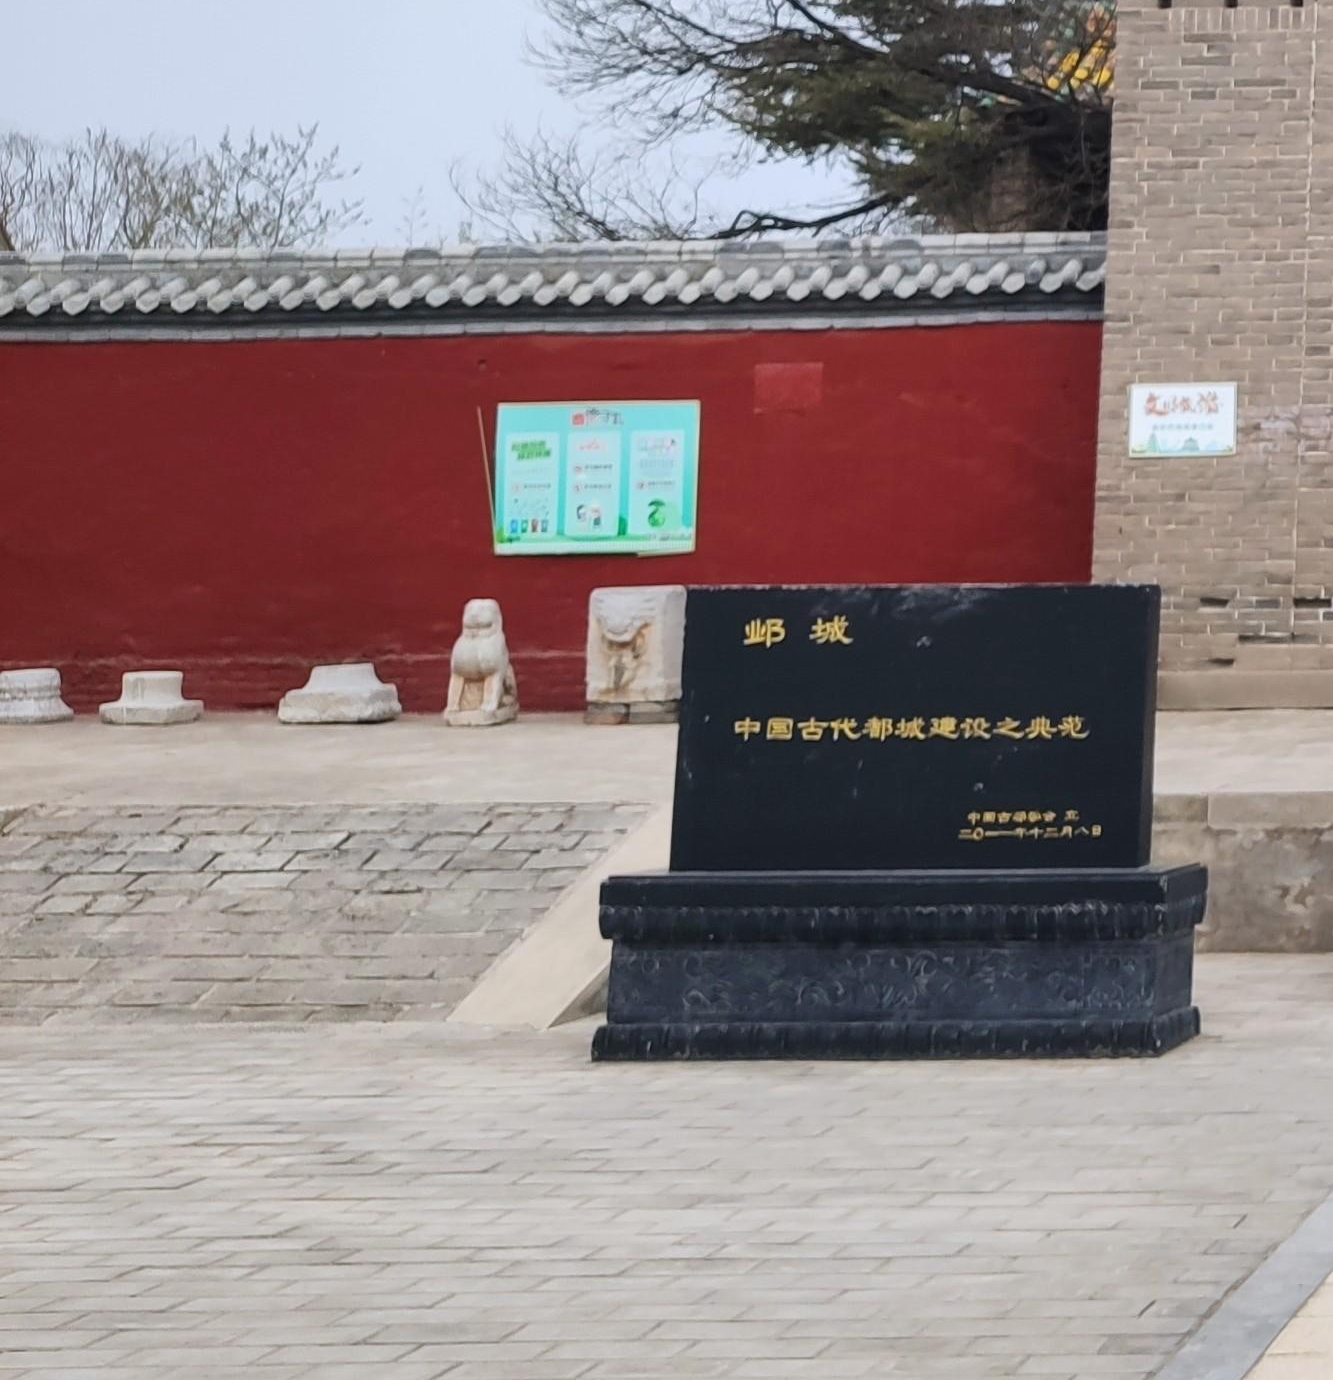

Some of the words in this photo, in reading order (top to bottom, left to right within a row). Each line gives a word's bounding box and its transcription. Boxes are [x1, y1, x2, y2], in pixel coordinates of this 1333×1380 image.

[743, 615, 853, 648] 邺城
[734, 715, 1089, 742] 中国古代都城建设之典范
